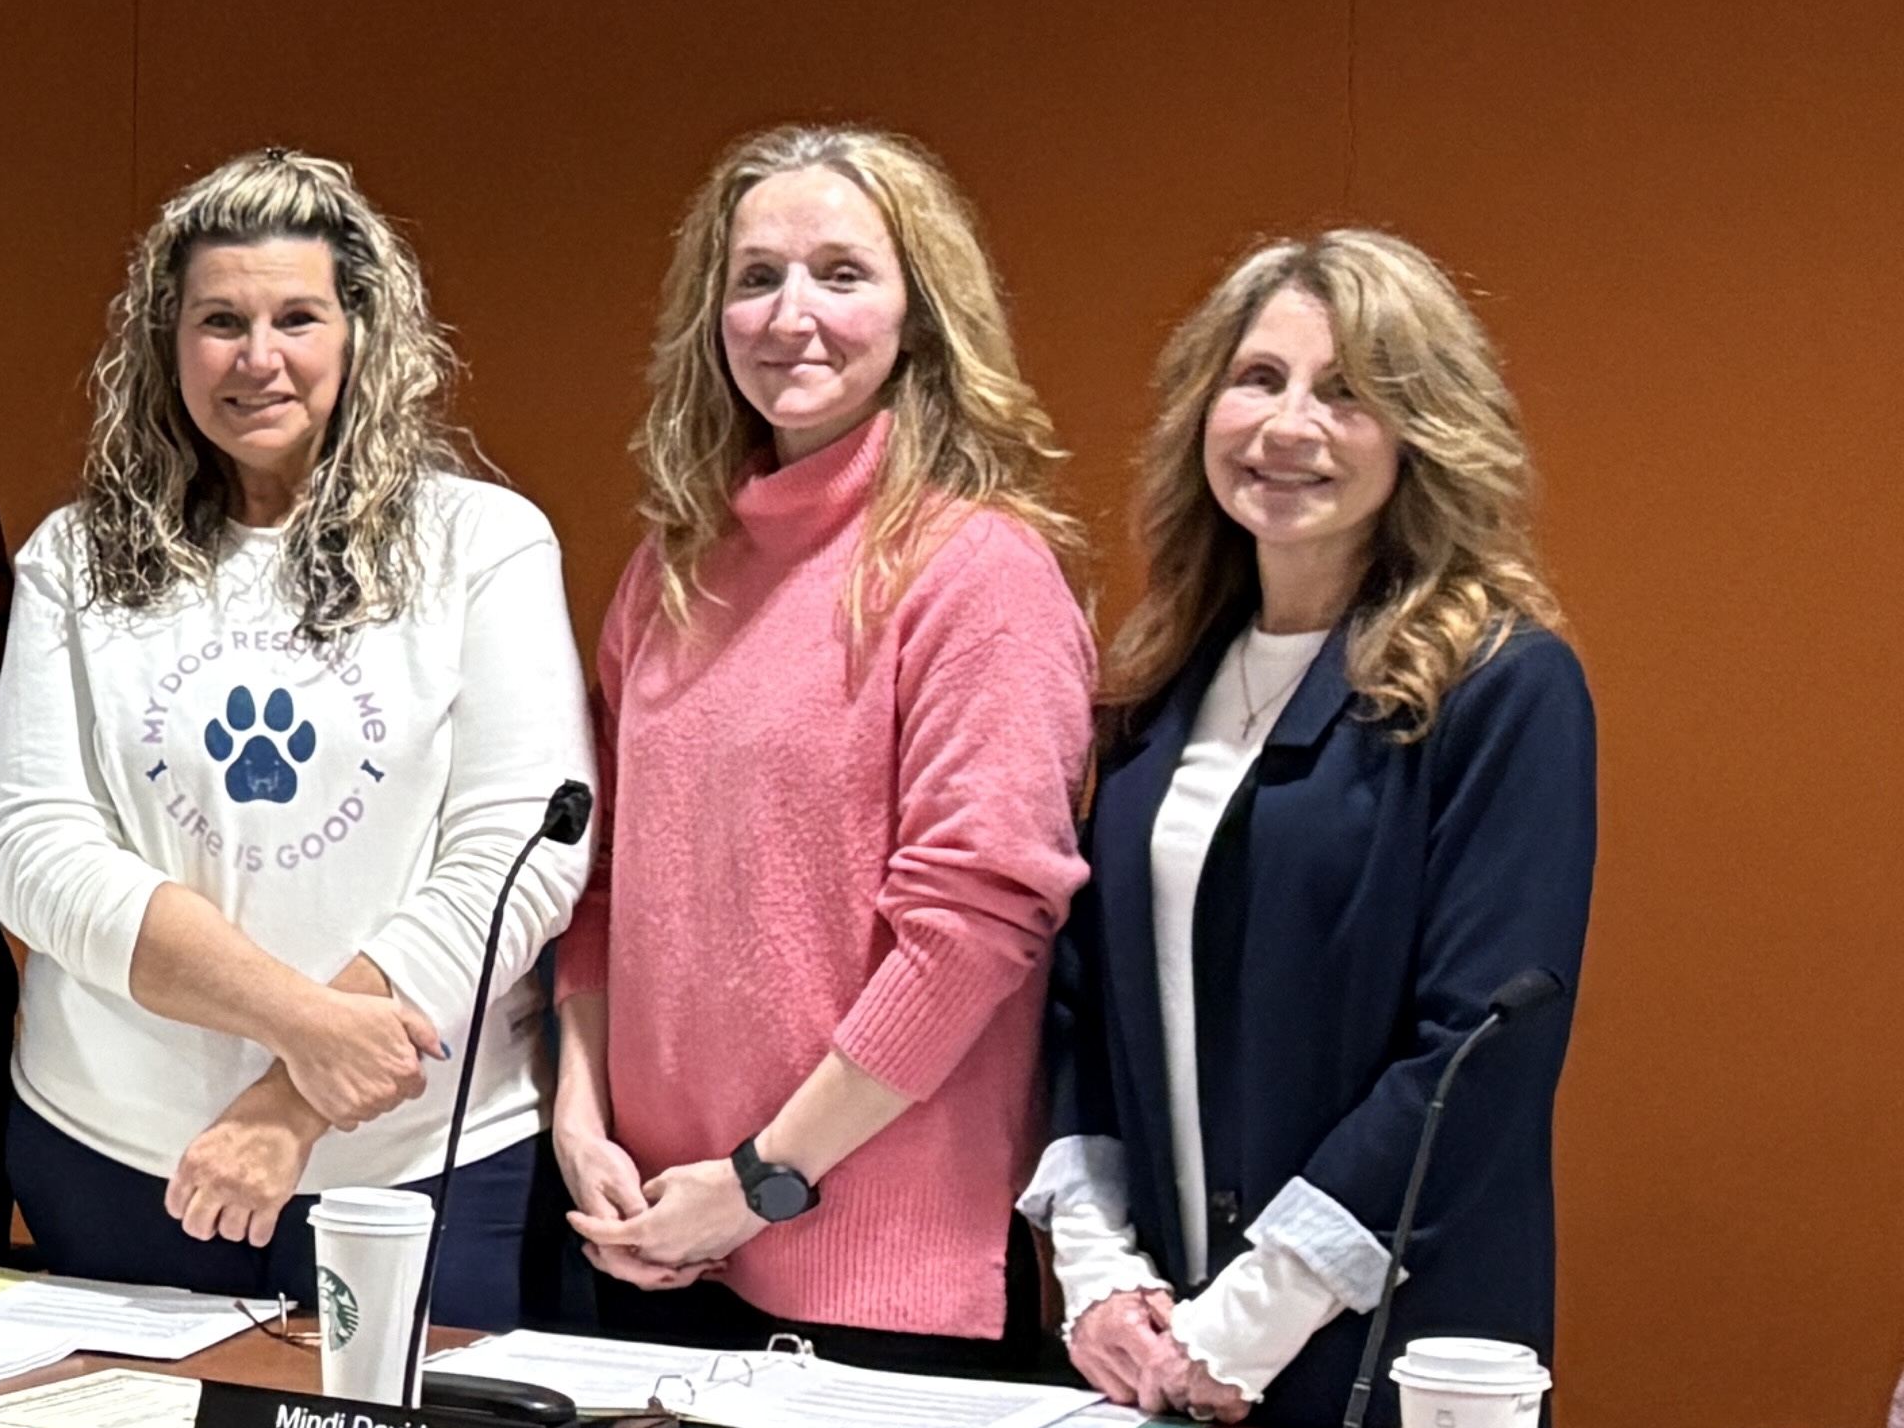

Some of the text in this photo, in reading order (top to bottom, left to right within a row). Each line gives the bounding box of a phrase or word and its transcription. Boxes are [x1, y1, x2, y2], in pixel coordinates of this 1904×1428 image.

[141, 696, 169, 744] MY
[158, 639, 224, 694] DOG
[232, 630, 363, 686] RESD
[233, 843, 264, 873] IS
[276, 796, 365, 871] GOOD
